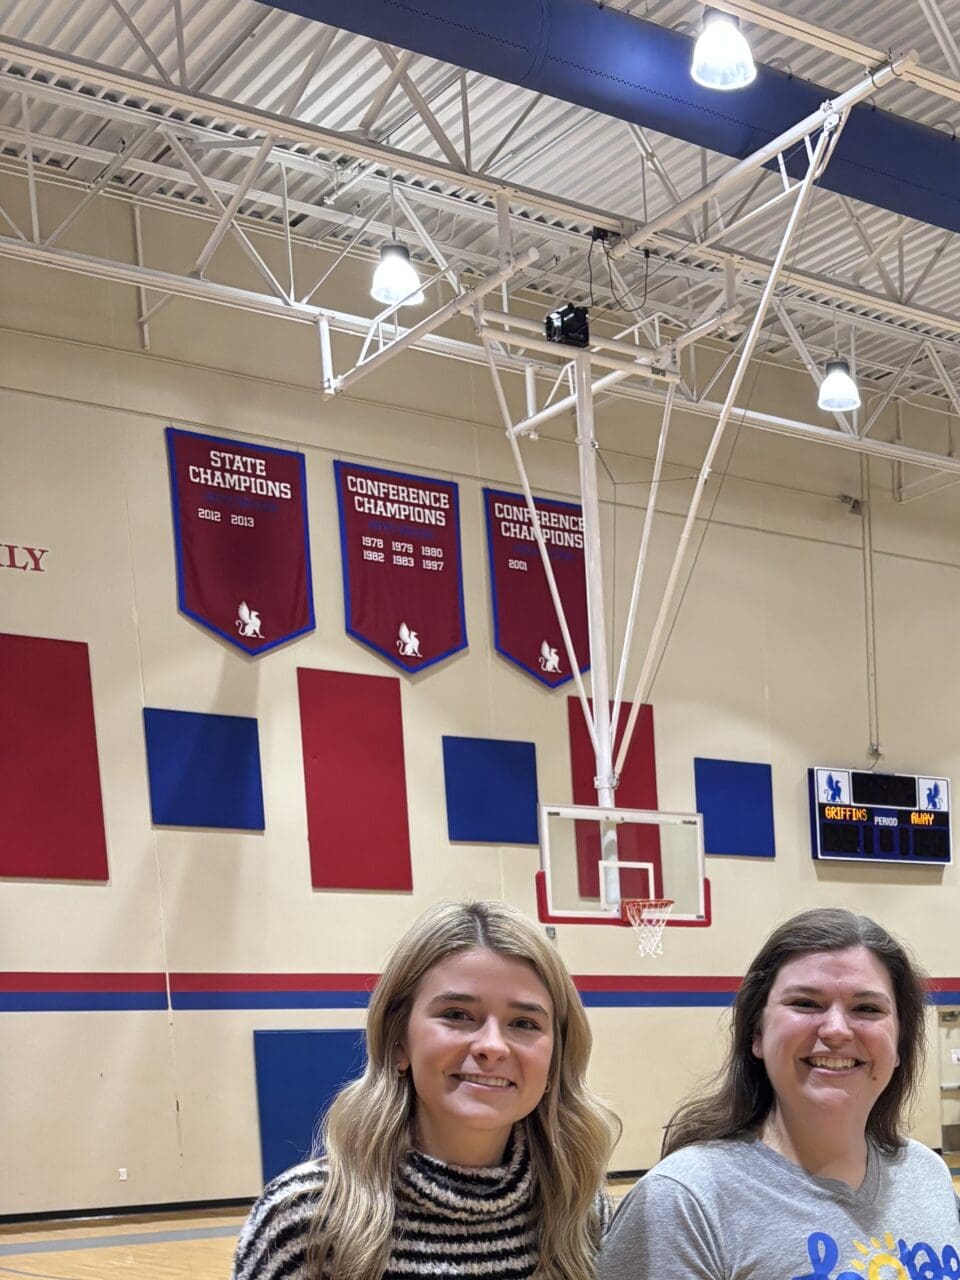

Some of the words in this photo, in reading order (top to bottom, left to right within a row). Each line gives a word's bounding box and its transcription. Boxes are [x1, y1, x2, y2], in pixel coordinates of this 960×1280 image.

[210, 450, 266, 476] STATE
[189, 465, 291, 499] CHAMPIONS
[347, 476, 449, 508] CONFERENCE
[198, 508, 221, 521] 2012
[231, 514, 254, 527] 2013
[354, 496, 446, 526] CHAMPIONS
[362, 536, 383, 548] 1978
[392, 541, 413, 553] 1979
[421, 546, 443, 558] 1980
[0, 544, 48, 572] LY
[393, 555, 414, 567] 1983
[422, 560, 444, 571] 1997
[508, 559, 527, 571] 2001
[825, 806, 868, 821] GRIFFINS
[874, 816, 898, 826] PERIOD
[910, 812, 934, 825] AWAY
